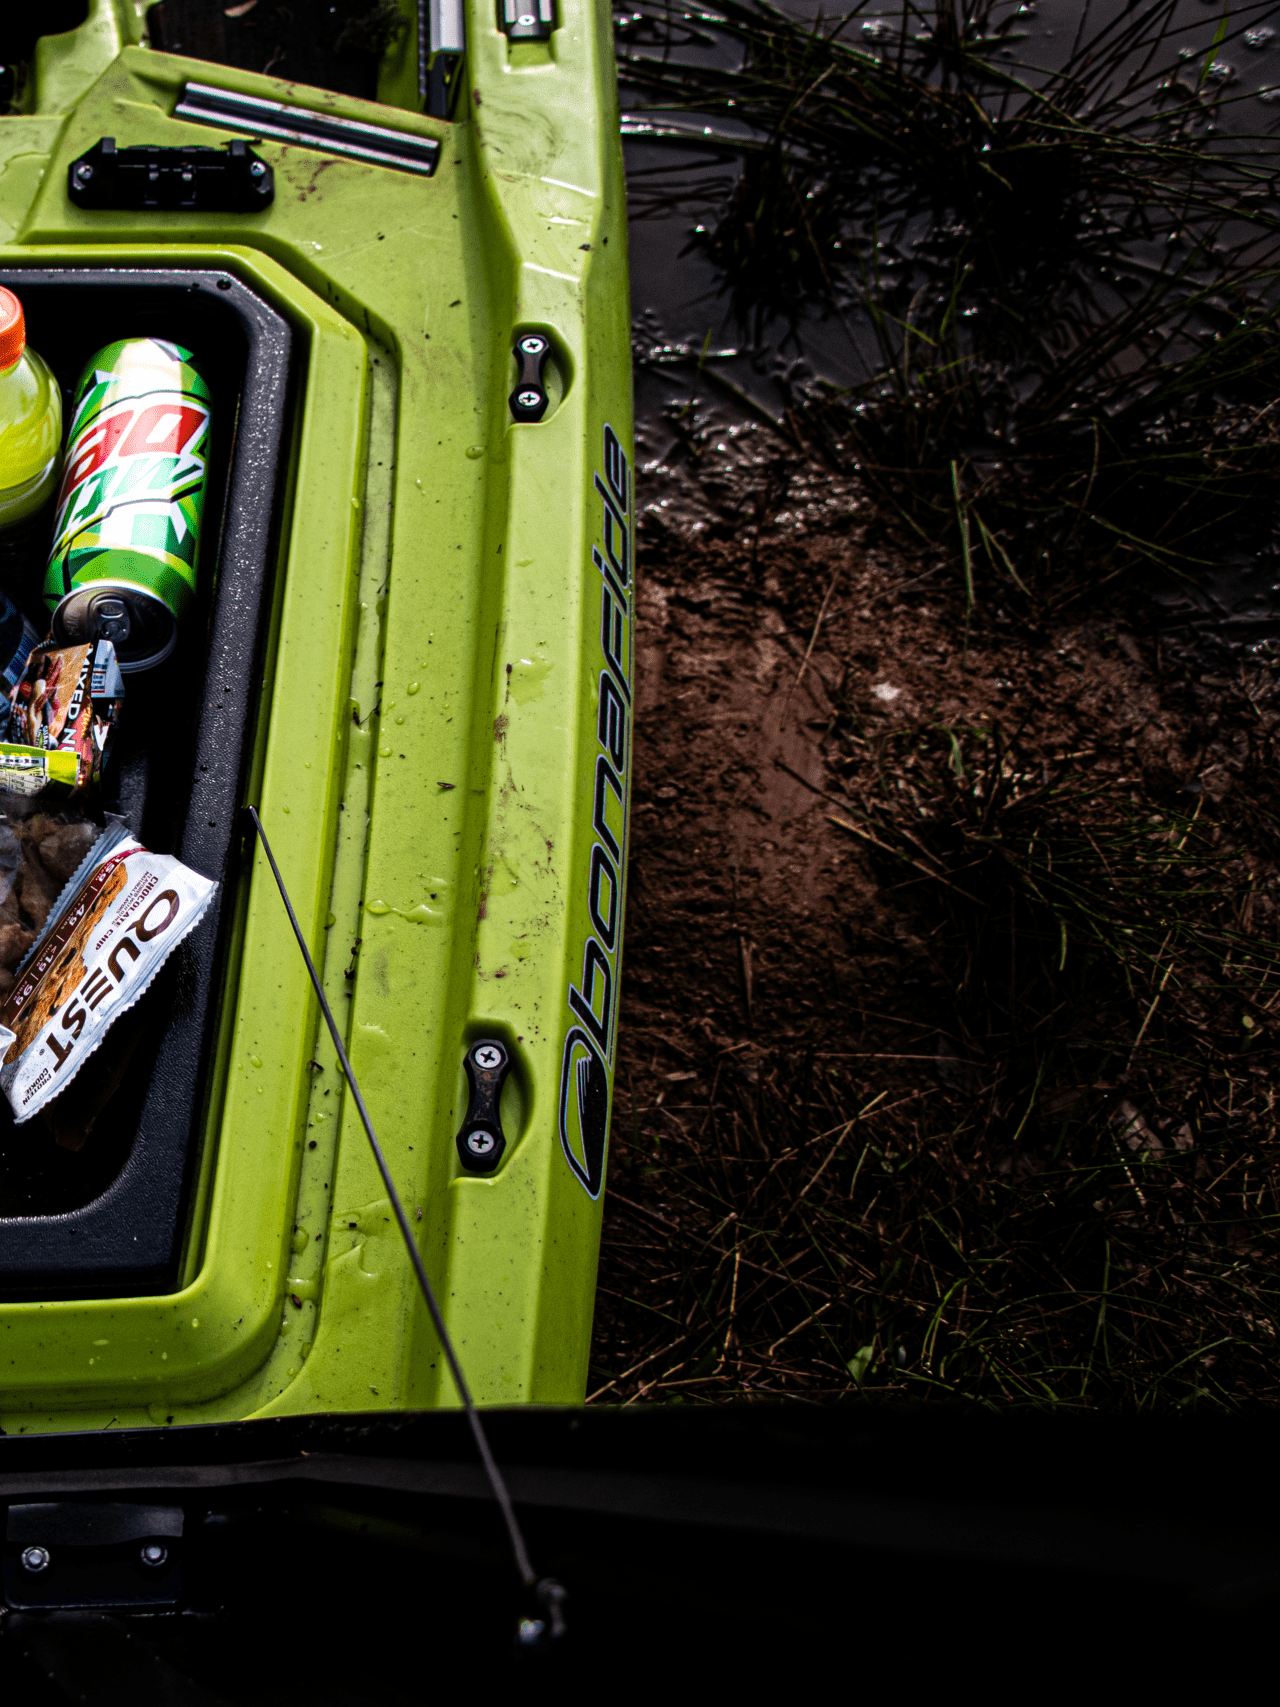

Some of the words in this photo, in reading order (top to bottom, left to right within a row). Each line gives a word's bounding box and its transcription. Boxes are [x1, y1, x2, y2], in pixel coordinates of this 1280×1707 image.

[67, 648, 93, 720] MIXED
[568, 423, 634, 1056] bonafide
[130, 870, 149, 892] NATURAL
[67, 902, 87, 926] 4g
[113, 875, 158, 927] CHOCOLATE
[93, 927, 113, 951] CHIP
[36, 943, 59, 972] <1g
[14, 983, 33, 1006] 9g
[46, 889, 180, 1074] QUEST
[22, 1072, 52, 1106] PROTEIN
[24, 1067, 49, 1096] COOKIE
